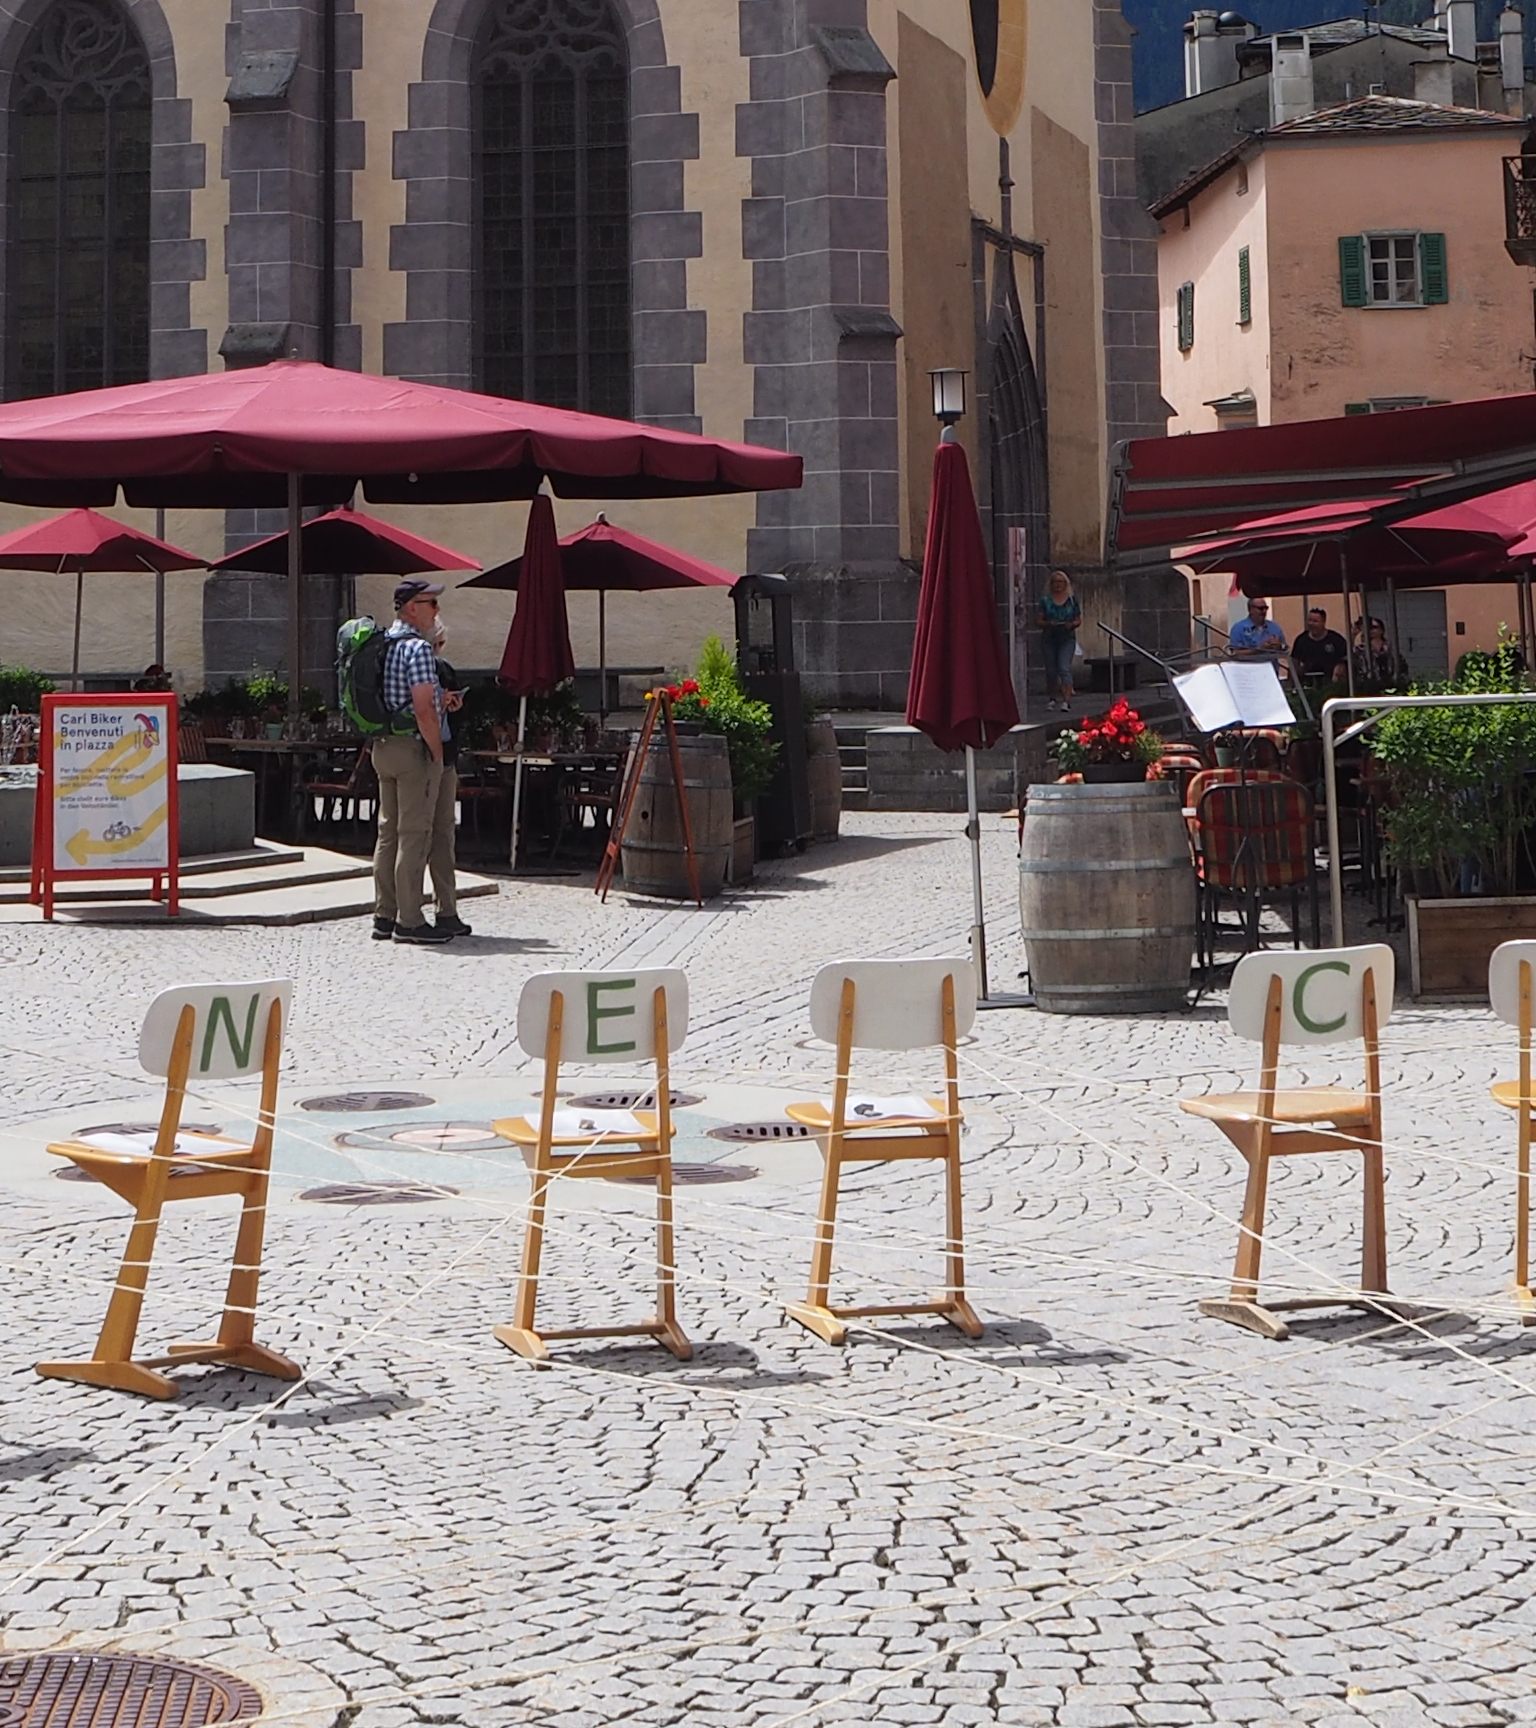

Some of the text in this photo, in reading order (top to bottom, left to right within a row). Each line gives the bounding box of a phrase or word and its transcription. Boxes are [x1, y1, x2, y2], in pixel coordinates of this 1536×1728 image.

[60, 713, 123, 725] Cari Biker
[60, 726, 124, 738] Benvenuti
[60, 739, 115, 752] in piazza
[1291, 961, 1351, 1035] C
[201, 993, 261, 1071] N
[586, 978, 636, 1055] E
